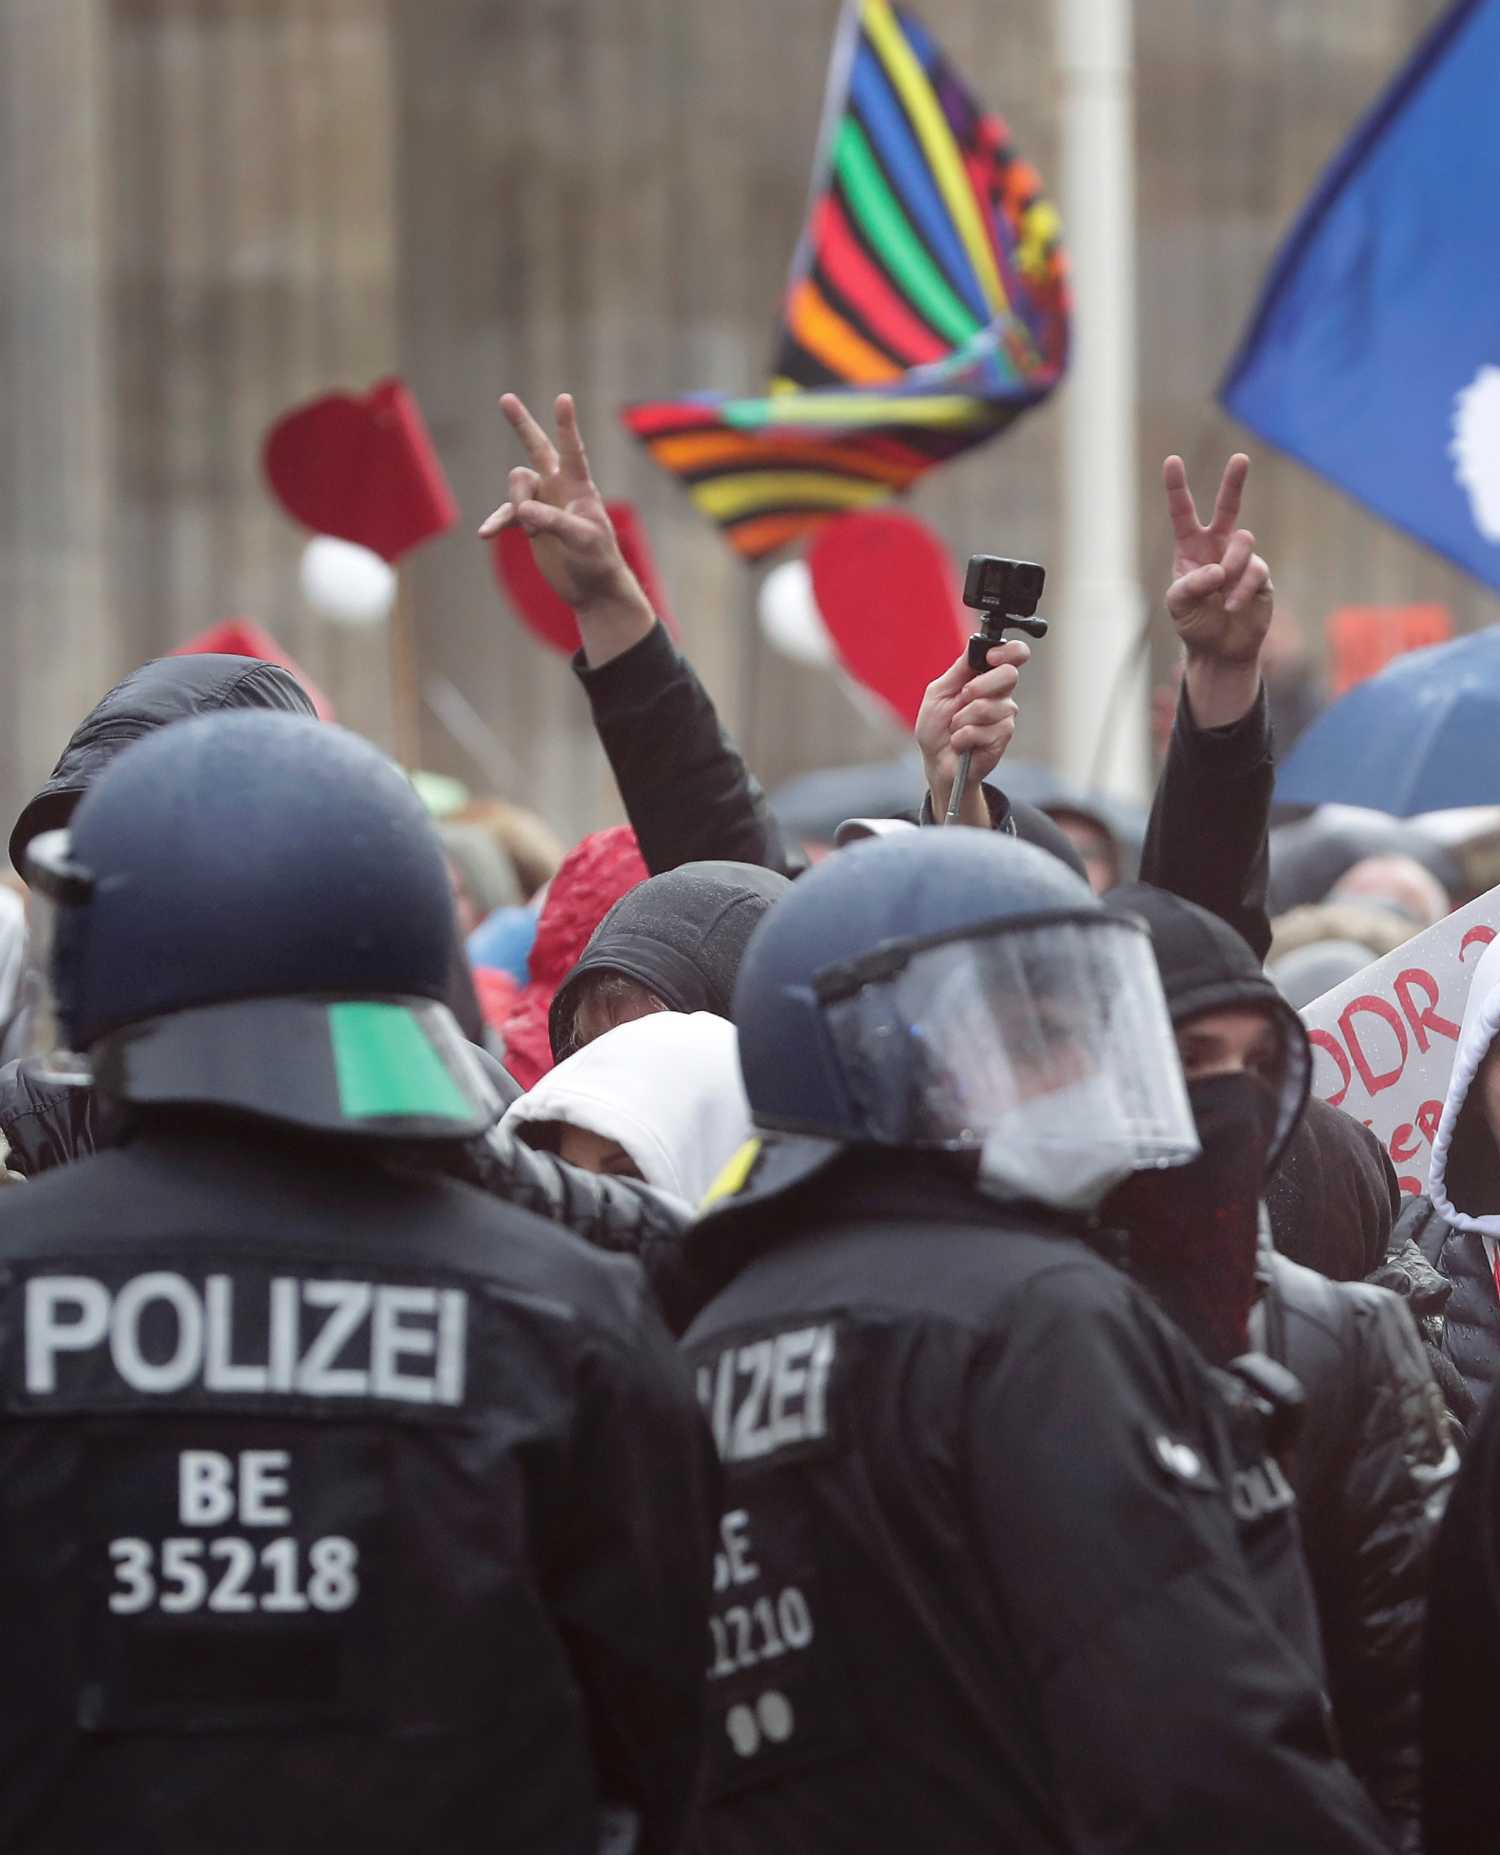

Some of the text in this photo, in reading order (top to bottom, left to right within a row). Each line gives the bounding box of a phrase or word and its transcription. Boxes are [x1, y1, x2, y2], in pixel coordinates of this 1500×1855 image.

[25, 1271, 467, 1405] POLIZEI
[696, 1323, 836, 1461] IZEI
[178, 1450, 290, 1526] BE
[108, 1537, 357, 1613] 35218
[712, 1509, 758, 1592] E
